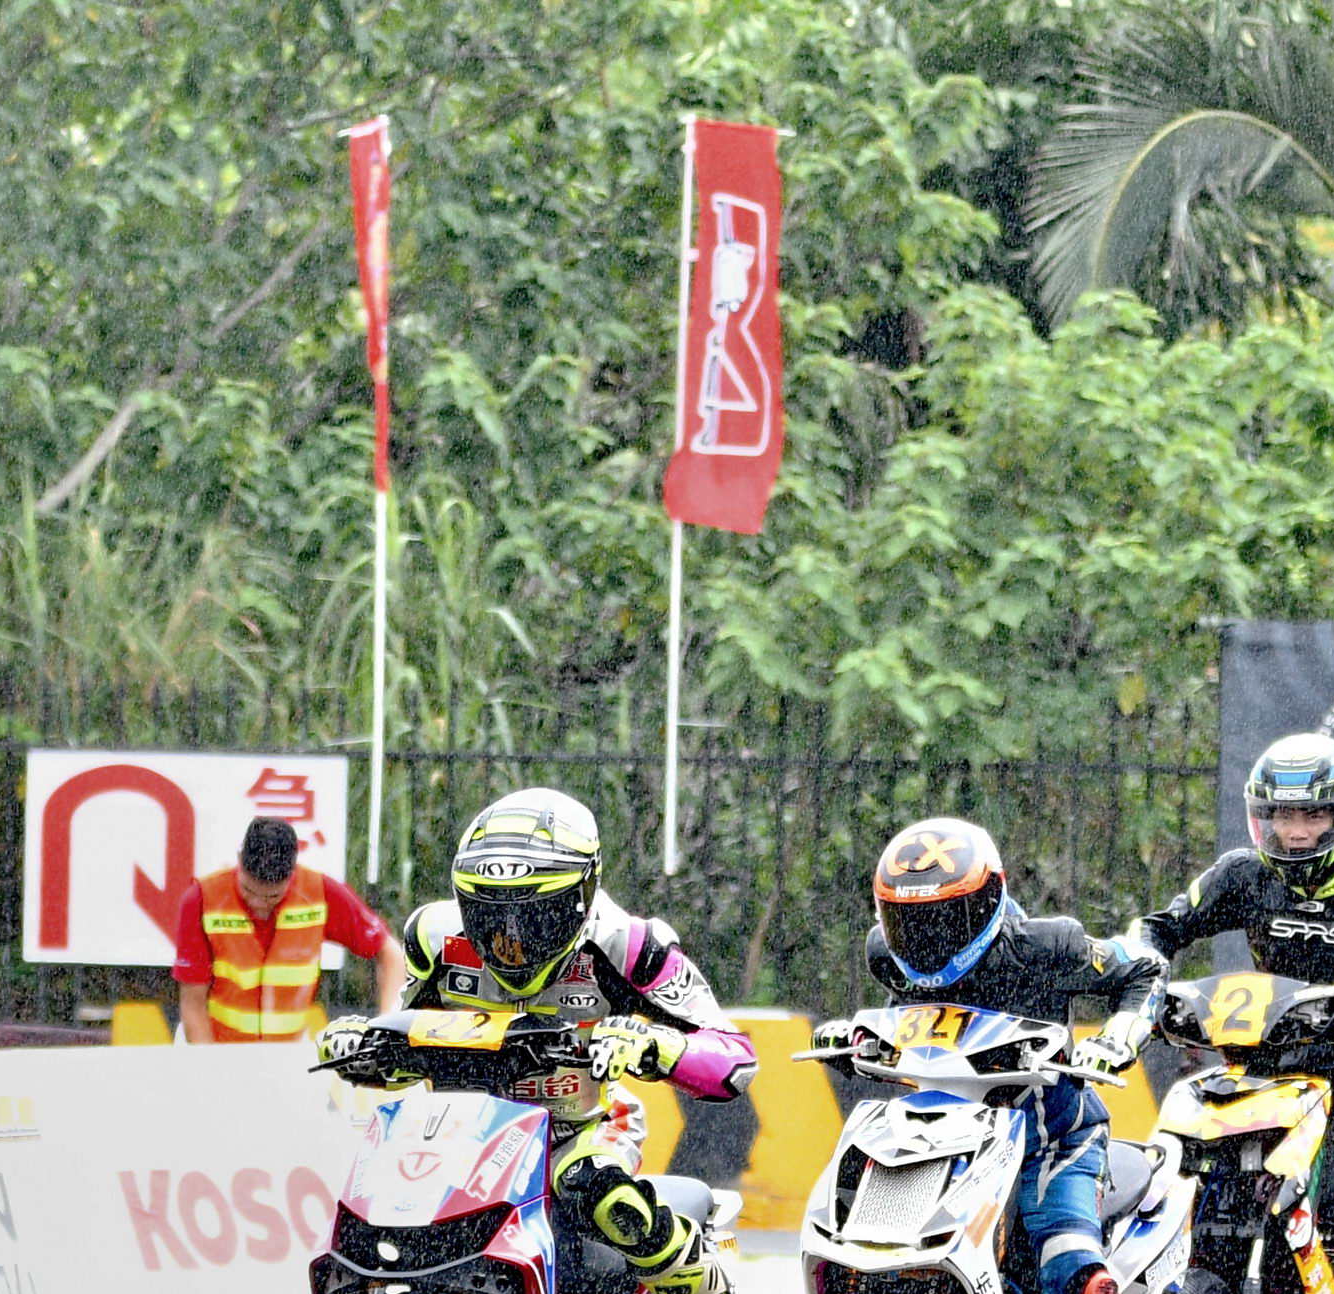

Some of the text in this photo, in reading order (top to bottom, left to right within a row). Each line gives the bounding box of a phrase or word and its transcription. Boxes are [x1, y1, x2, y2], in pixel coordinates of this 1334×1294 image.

[478, 862, 532, 879] KYT
[1221, 987, 1253, 1034] 2
[425, 1012, 492, 1041] 22
